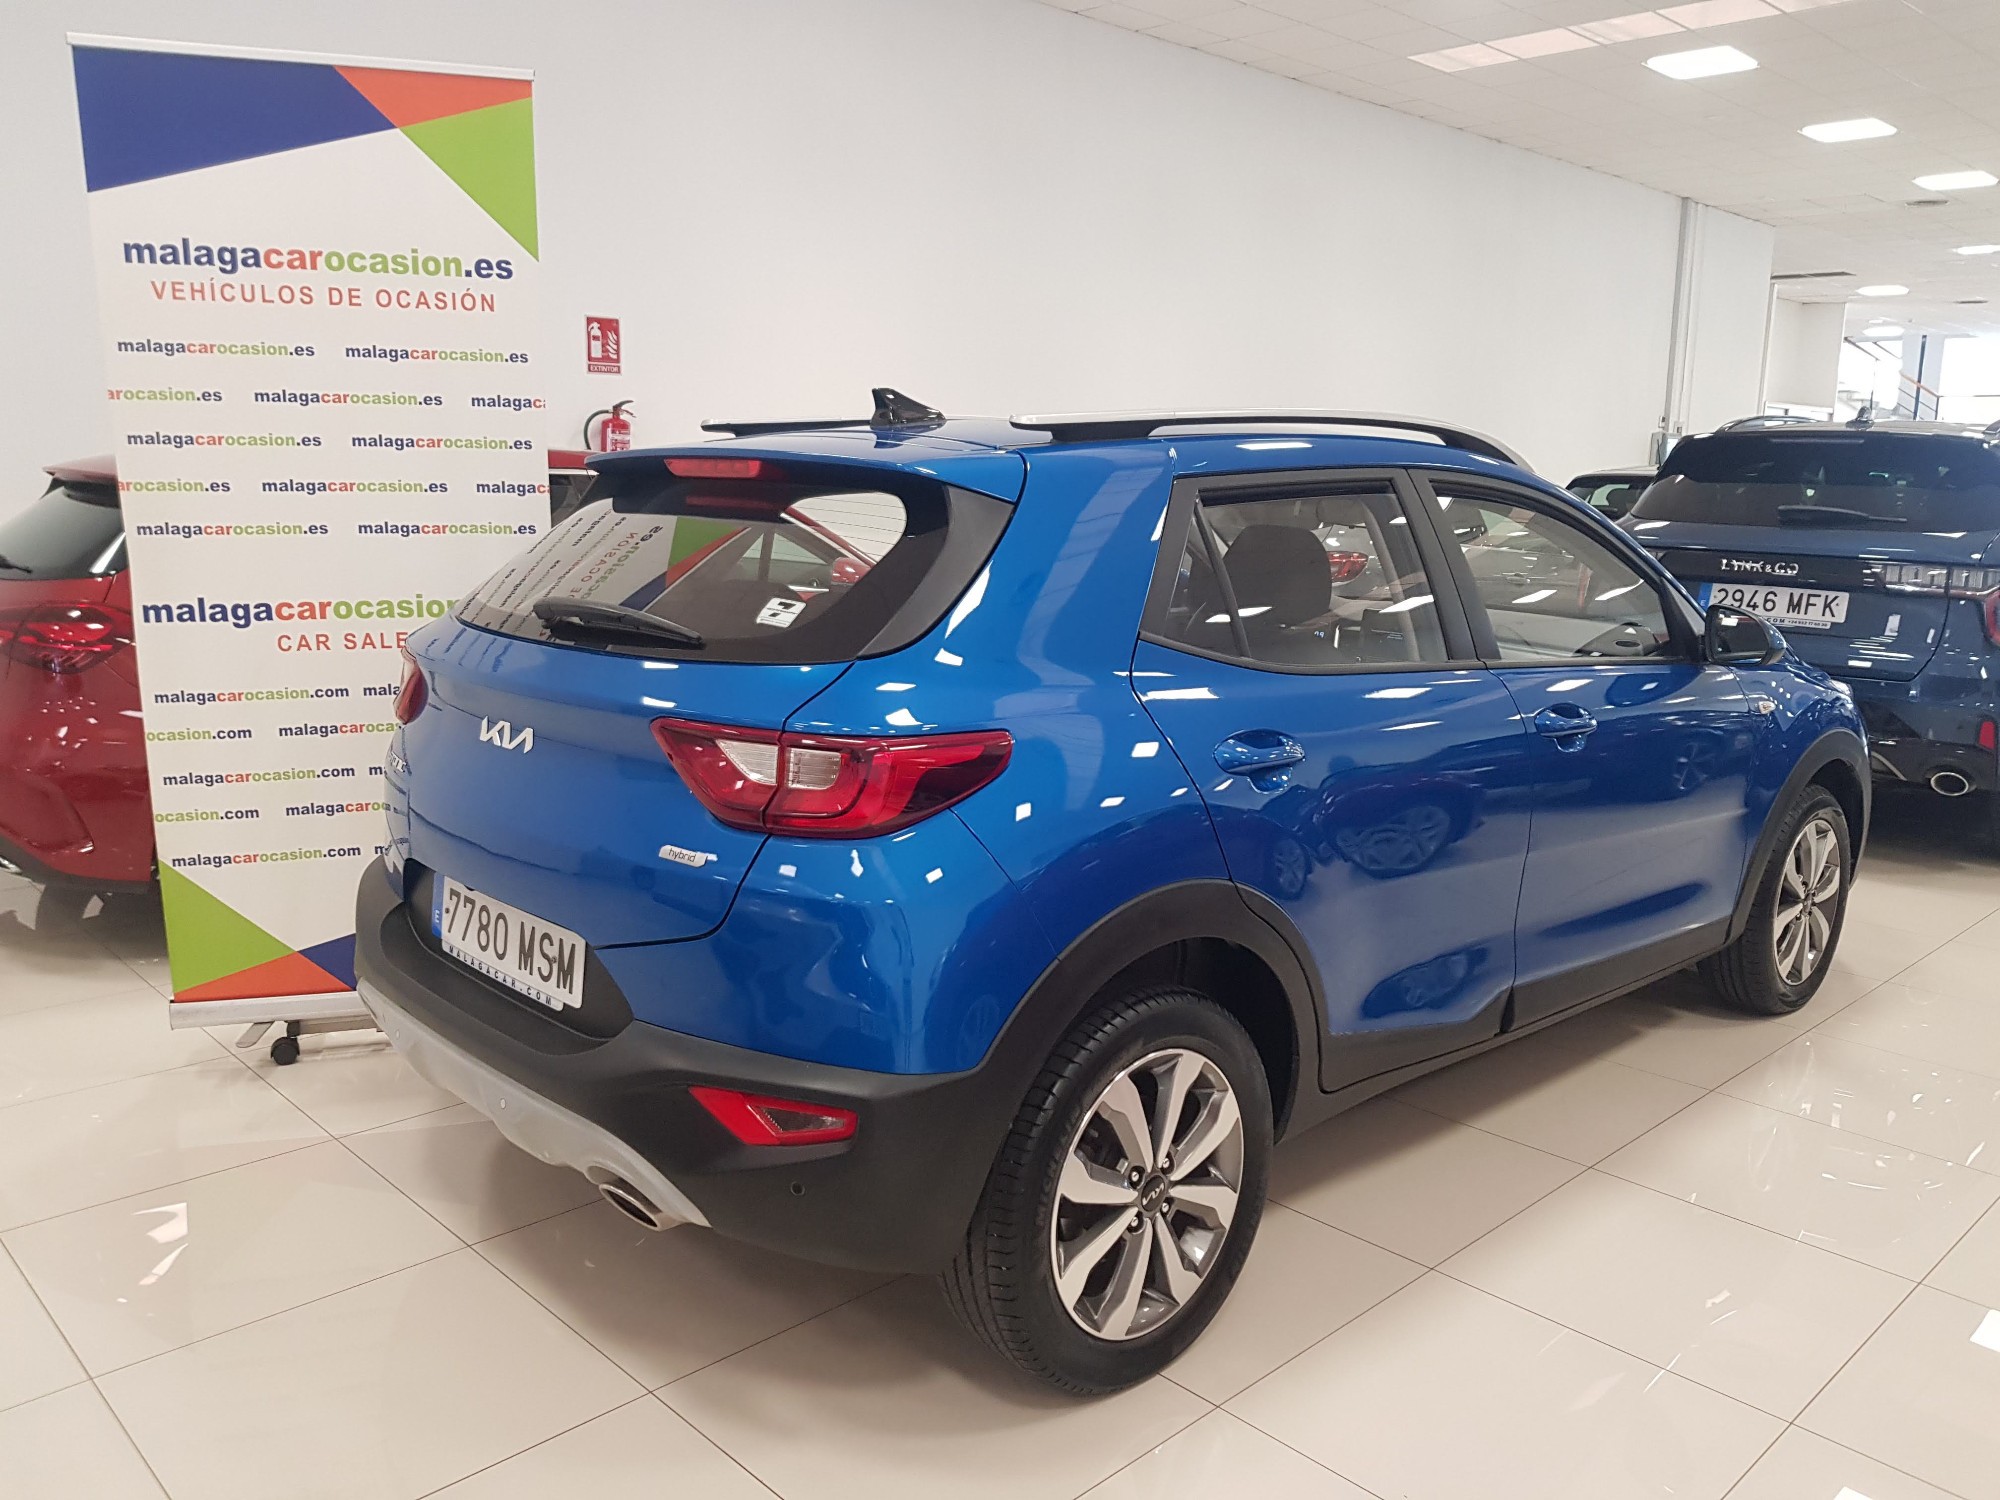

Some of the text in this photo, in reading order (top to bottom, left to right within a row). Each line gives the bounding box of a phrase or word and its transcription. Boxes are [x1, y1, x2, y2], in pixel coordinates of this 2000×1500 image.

[123, 236, 514, 281] malagacarocasion.es
[151, 277, 495, 313] VEHÍCULOS DE OCASIÓN
[117, 338, 315, 357] malagacarocasion.es
[344, 344, 529, 364] malagacarocasion.es
[590, 364, 619, 372] EXTINTOR
[253, 388, 443, 407] malagacarocasion.es
[127, 431, 322, 449] malagacarocasion.es
[351, 433, 533, 451] malagacarocasion.es
[261, 478, 448, 496] malagacarocasion.es
[136, 521, 329, 539] malagacarocasion.es
[357, 520, 537, 536] malagacarocasion.es
[1716, 588, 1840, 618] 2946 MFK
[277, 634, 332, 652] CAR
[154, 686, 350, 705] malagacarocasion.com
[147, 728, 252, 742] ocasion.com
[479, 715, 535, 753] KIA
[163, 765, 356, 787] malagacarocasion.com
[155, 809, 260, 823] ocasion.com
[172, 845, 362, 869] malagacarocasion.com
[668, 847, 697, 863] hybrid
[447, 887, 576, 995] 7780 MSM
[448, 945, 552, 1006] MALAGACAR.COM
